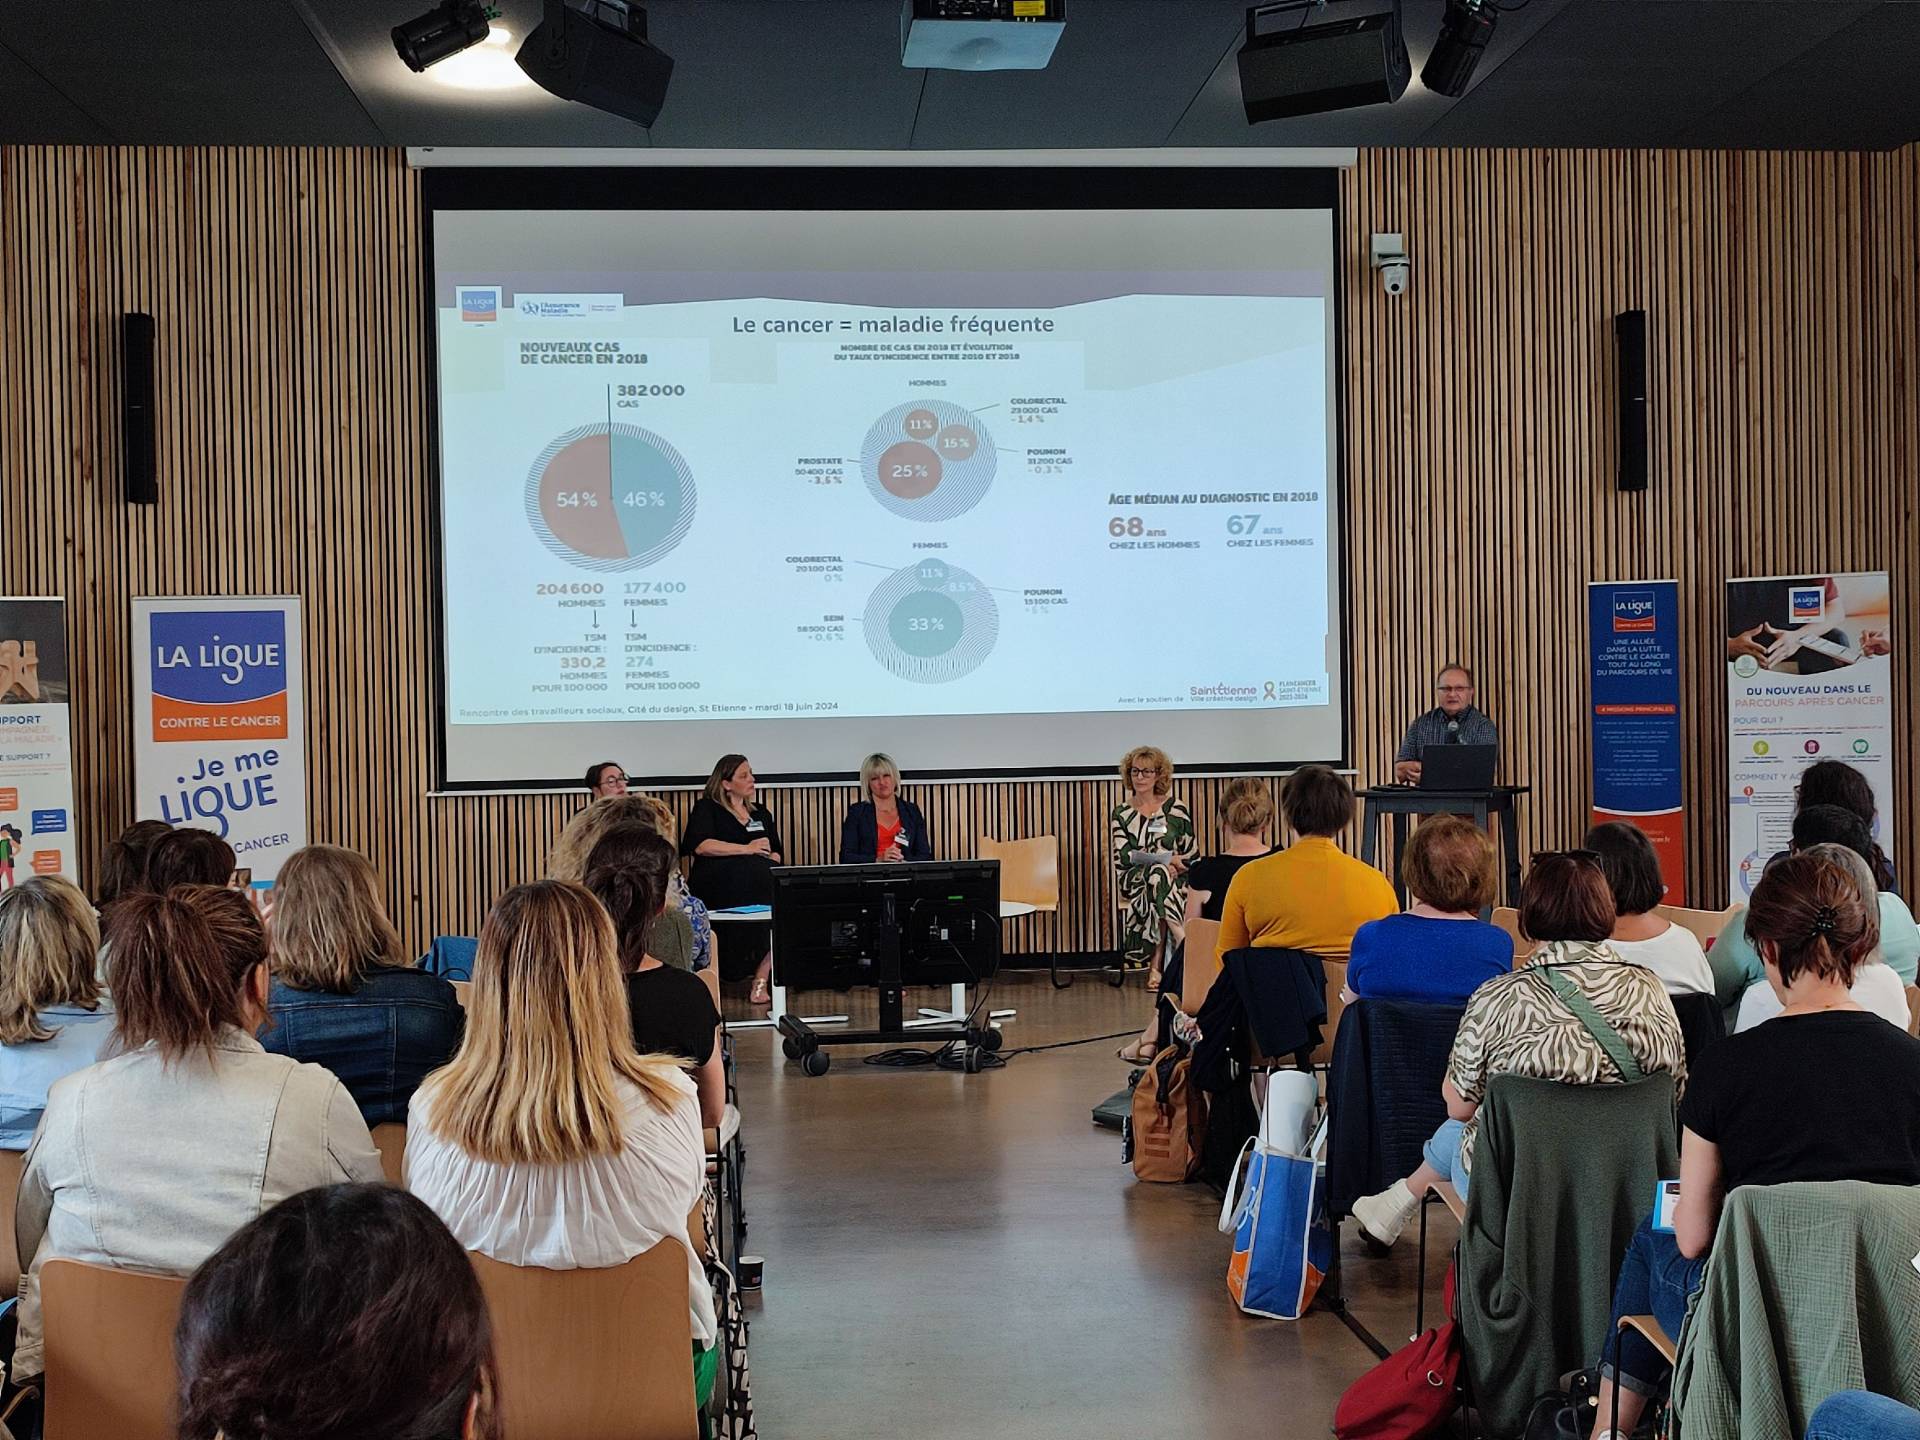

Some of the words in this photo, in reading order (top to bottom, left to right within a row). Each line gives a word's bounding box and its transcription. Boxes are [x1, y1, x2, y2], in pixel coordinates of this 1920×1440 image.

[733, 317, 755, 333] Le
[763, 319, 833, 333] cancer
[859, 316, 943, 332] maladie
[950, 315, 1054, 336] fréquente
[520, 343, 592, 352] NOUVEAUX
[594, 342, 620, 352] CAS
[520, 354, 538, 364] DE
[541, 354, 593, 364] CANCER
[596, 354, 614, 364] EN
[617, 354, 648, 364] 2018
[617, 400, 639, 408] CAS
[1109, 493, 1132, 505] ÂGE
[1134, 492, 1179, 504] MÉDIAN
[1181, 494, 1198, 504] AU
[1200, 493, 1269, 504] DIAGNOSTIC
[1273, 493, 1289, 503] EN
[1291, 492, 1318, 502] 2018
[1109, 517, 1144, 537] 68
[1146, 528, 1167, 537] ans
[1226, 514, 1261, 535] 67
[1262, 526, 1283, 535] ans
[1109, 542, 1136, 550] CHEZ
[1137, 541, 1155, 549] LES
[1157, 541, 1200, 549] HOMMES
[1227, 540, 1253, 548] CHEZ
[1255, 539, 1273, 547] LES
[1274, 538, 1314, 546] FEMMES
[558, 600, 606, 608] HOMMES
[624, 599, 668, 607] FEMMES
[1616, 602, 1626, 610] LA
[624, 633, 647, 641] TSM
[158, 646, 191, 668] LA
[626, 656, 654, 667] 274
[560, 657, 606, 669] 330,2
[560, 672, 608, 680] HOMMES
[625, 671, 670, 679] FEMMES
[625, 682, 656, 691] POUR
[1747, 687, 1762, 696] DU
[1765, 686, 1821, 695] NOUVEAU
[1824, 685, 1855, 694] DANS
[1858, 684, 1871, 693] LE
[1735, 698, 1794, 708] PARCOURS
[1837, 696, 1885, 706] CANCER
[460, 709, 509, 717] Rencontre
[511, 708, 528, 716] des
[531, 707, 584, 716] travailleurs
[627, 705, 647, 714] Cité
[649, 705, 662, 714] du
[699, 705, 709, 713] St
[711, 704, 747, 712] Etienne
[755, 703, 782, 712] mardi
[784, 703, 794, 711] 18
[796, 703, 813, 712] juin
[815, 702, 839, 711] 2024
[160, 718, 209, 729] CONTRE
[213, 717, 227, 728] LE
[231, 715, 281, 727] CANCER
[192, 758, 224, 781] Je
[235, 749, 279, 772] me
[1735, 773, 1778, 782] COMMENT
[234, 833, 289, 854] CANCER
